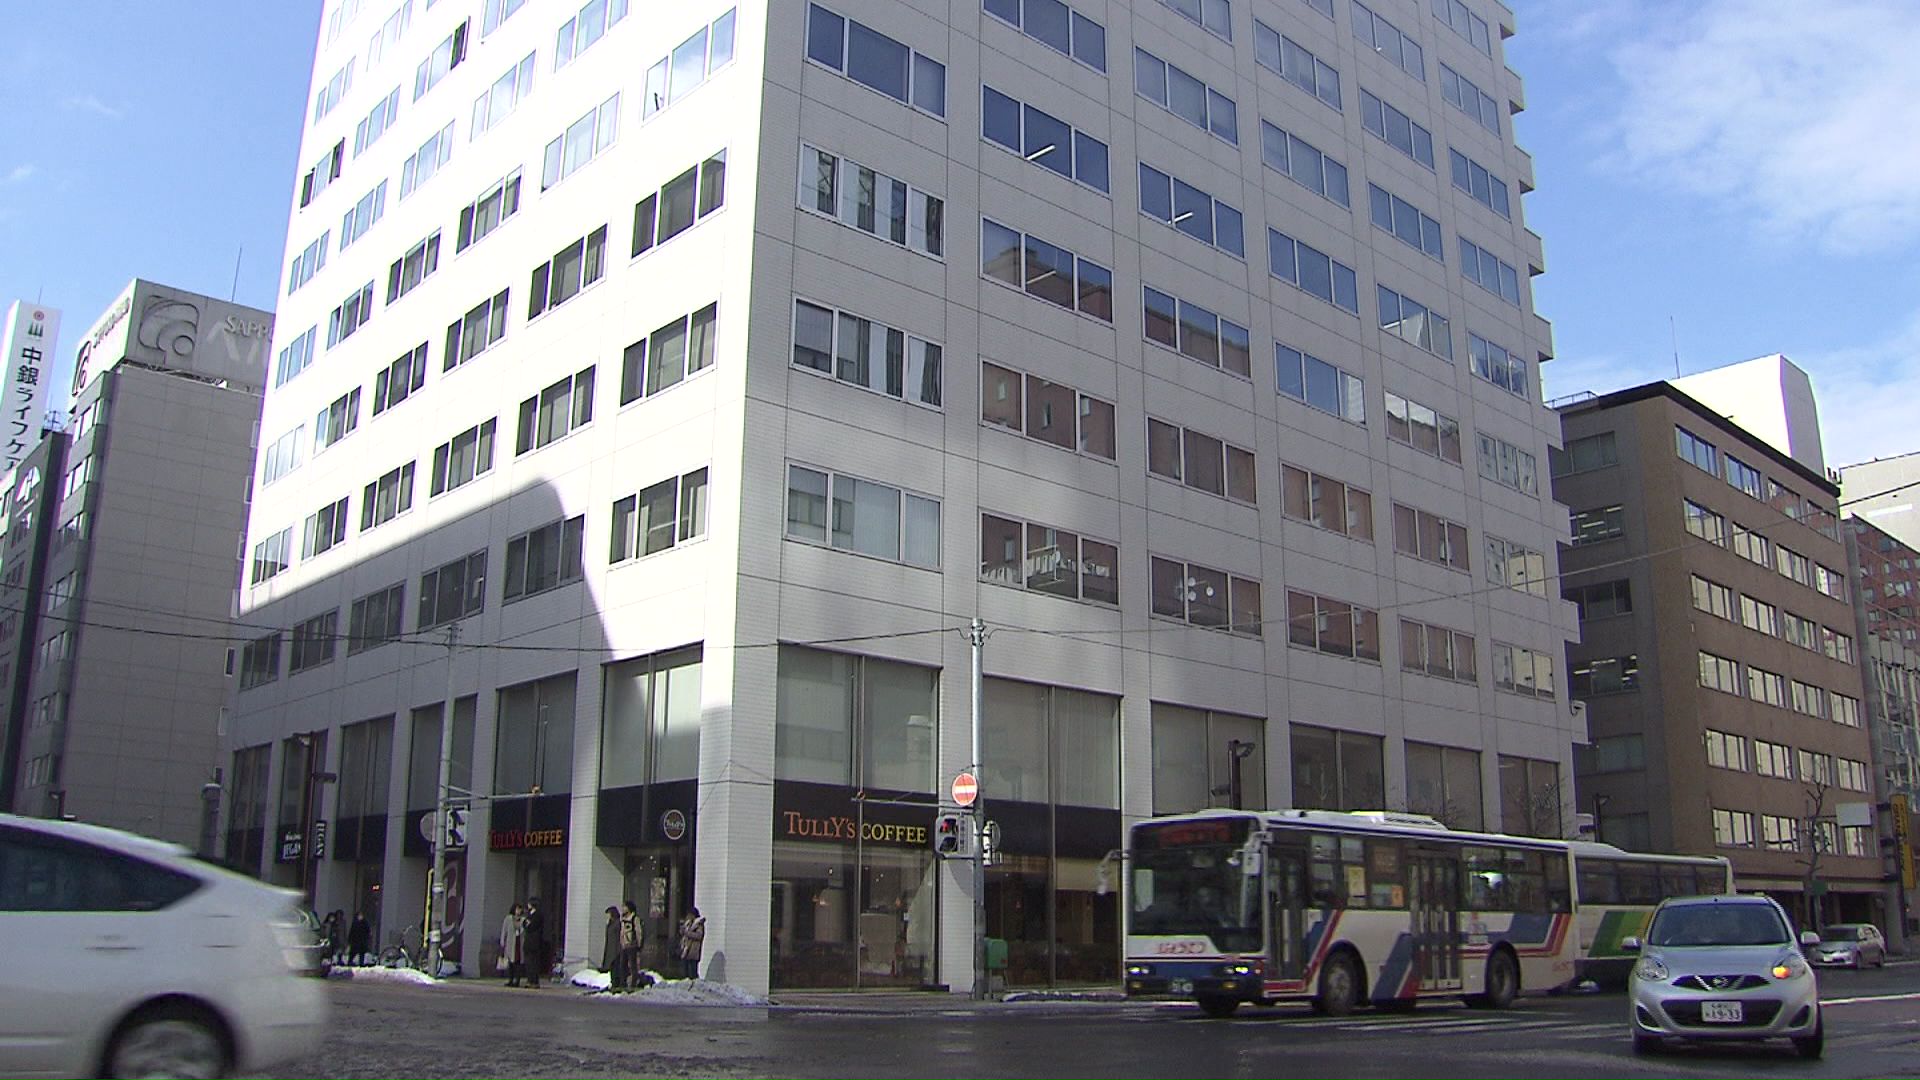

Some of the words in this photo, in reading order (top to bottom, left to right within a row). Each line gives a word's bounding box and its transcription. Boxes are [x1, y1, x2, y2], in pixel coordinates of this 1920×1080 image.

[491, 829, 523, 848] TULLY'S
[524, 829, 563, 848] COFFEE
[784, 811, 856, 839] TULLY'S
[861, 822, 927, 844] COFFEE
